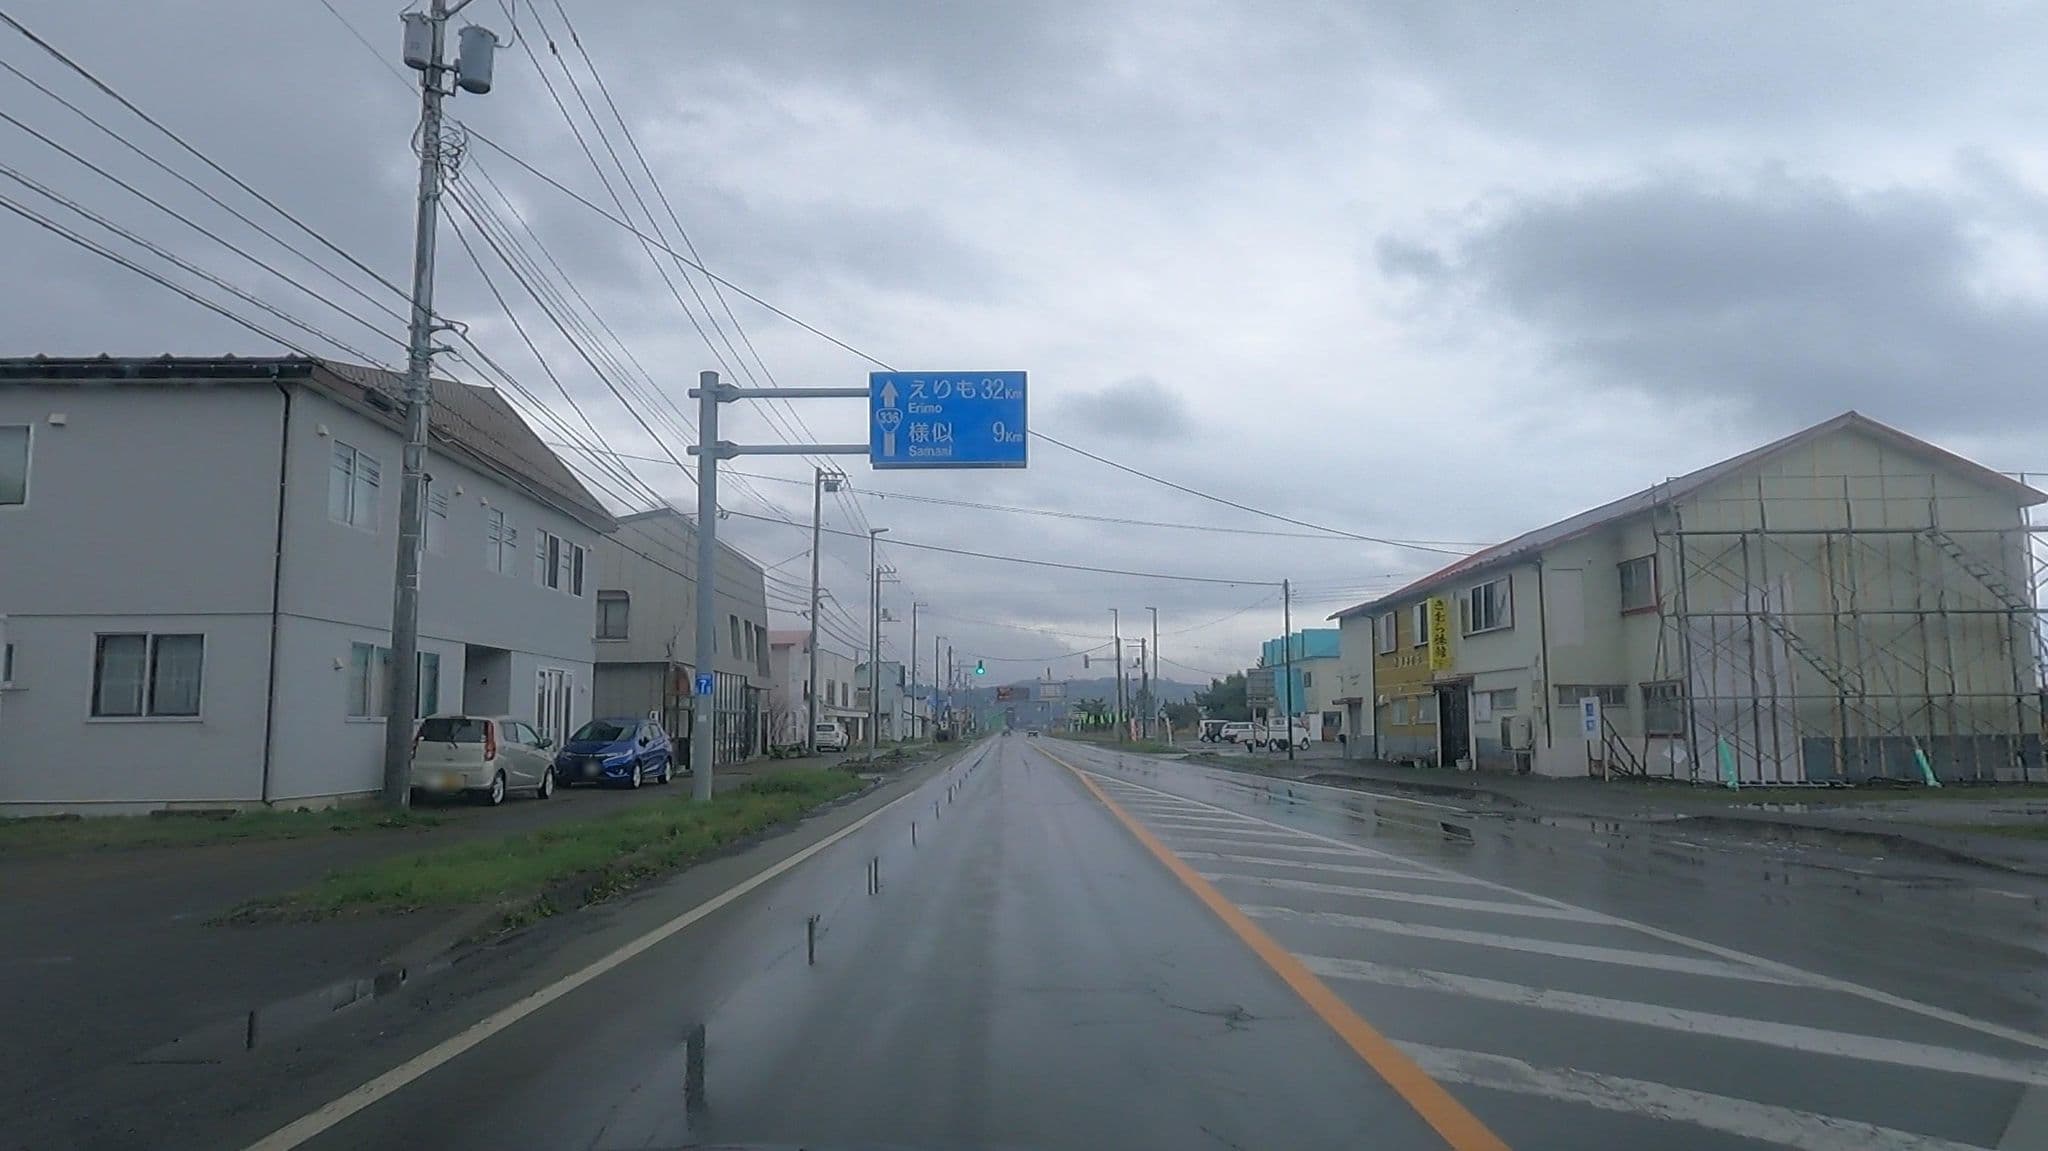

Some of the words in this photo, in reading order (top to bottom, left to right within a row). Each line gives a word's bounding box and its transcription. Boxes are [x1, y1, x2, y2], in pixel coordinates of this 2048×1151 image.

[909, 379, 976, 399] えりも
[908, 402, 943, 413] Erimo
[909, 422, 954, 443] 様似
[909, 445, 952, 456] Samani
